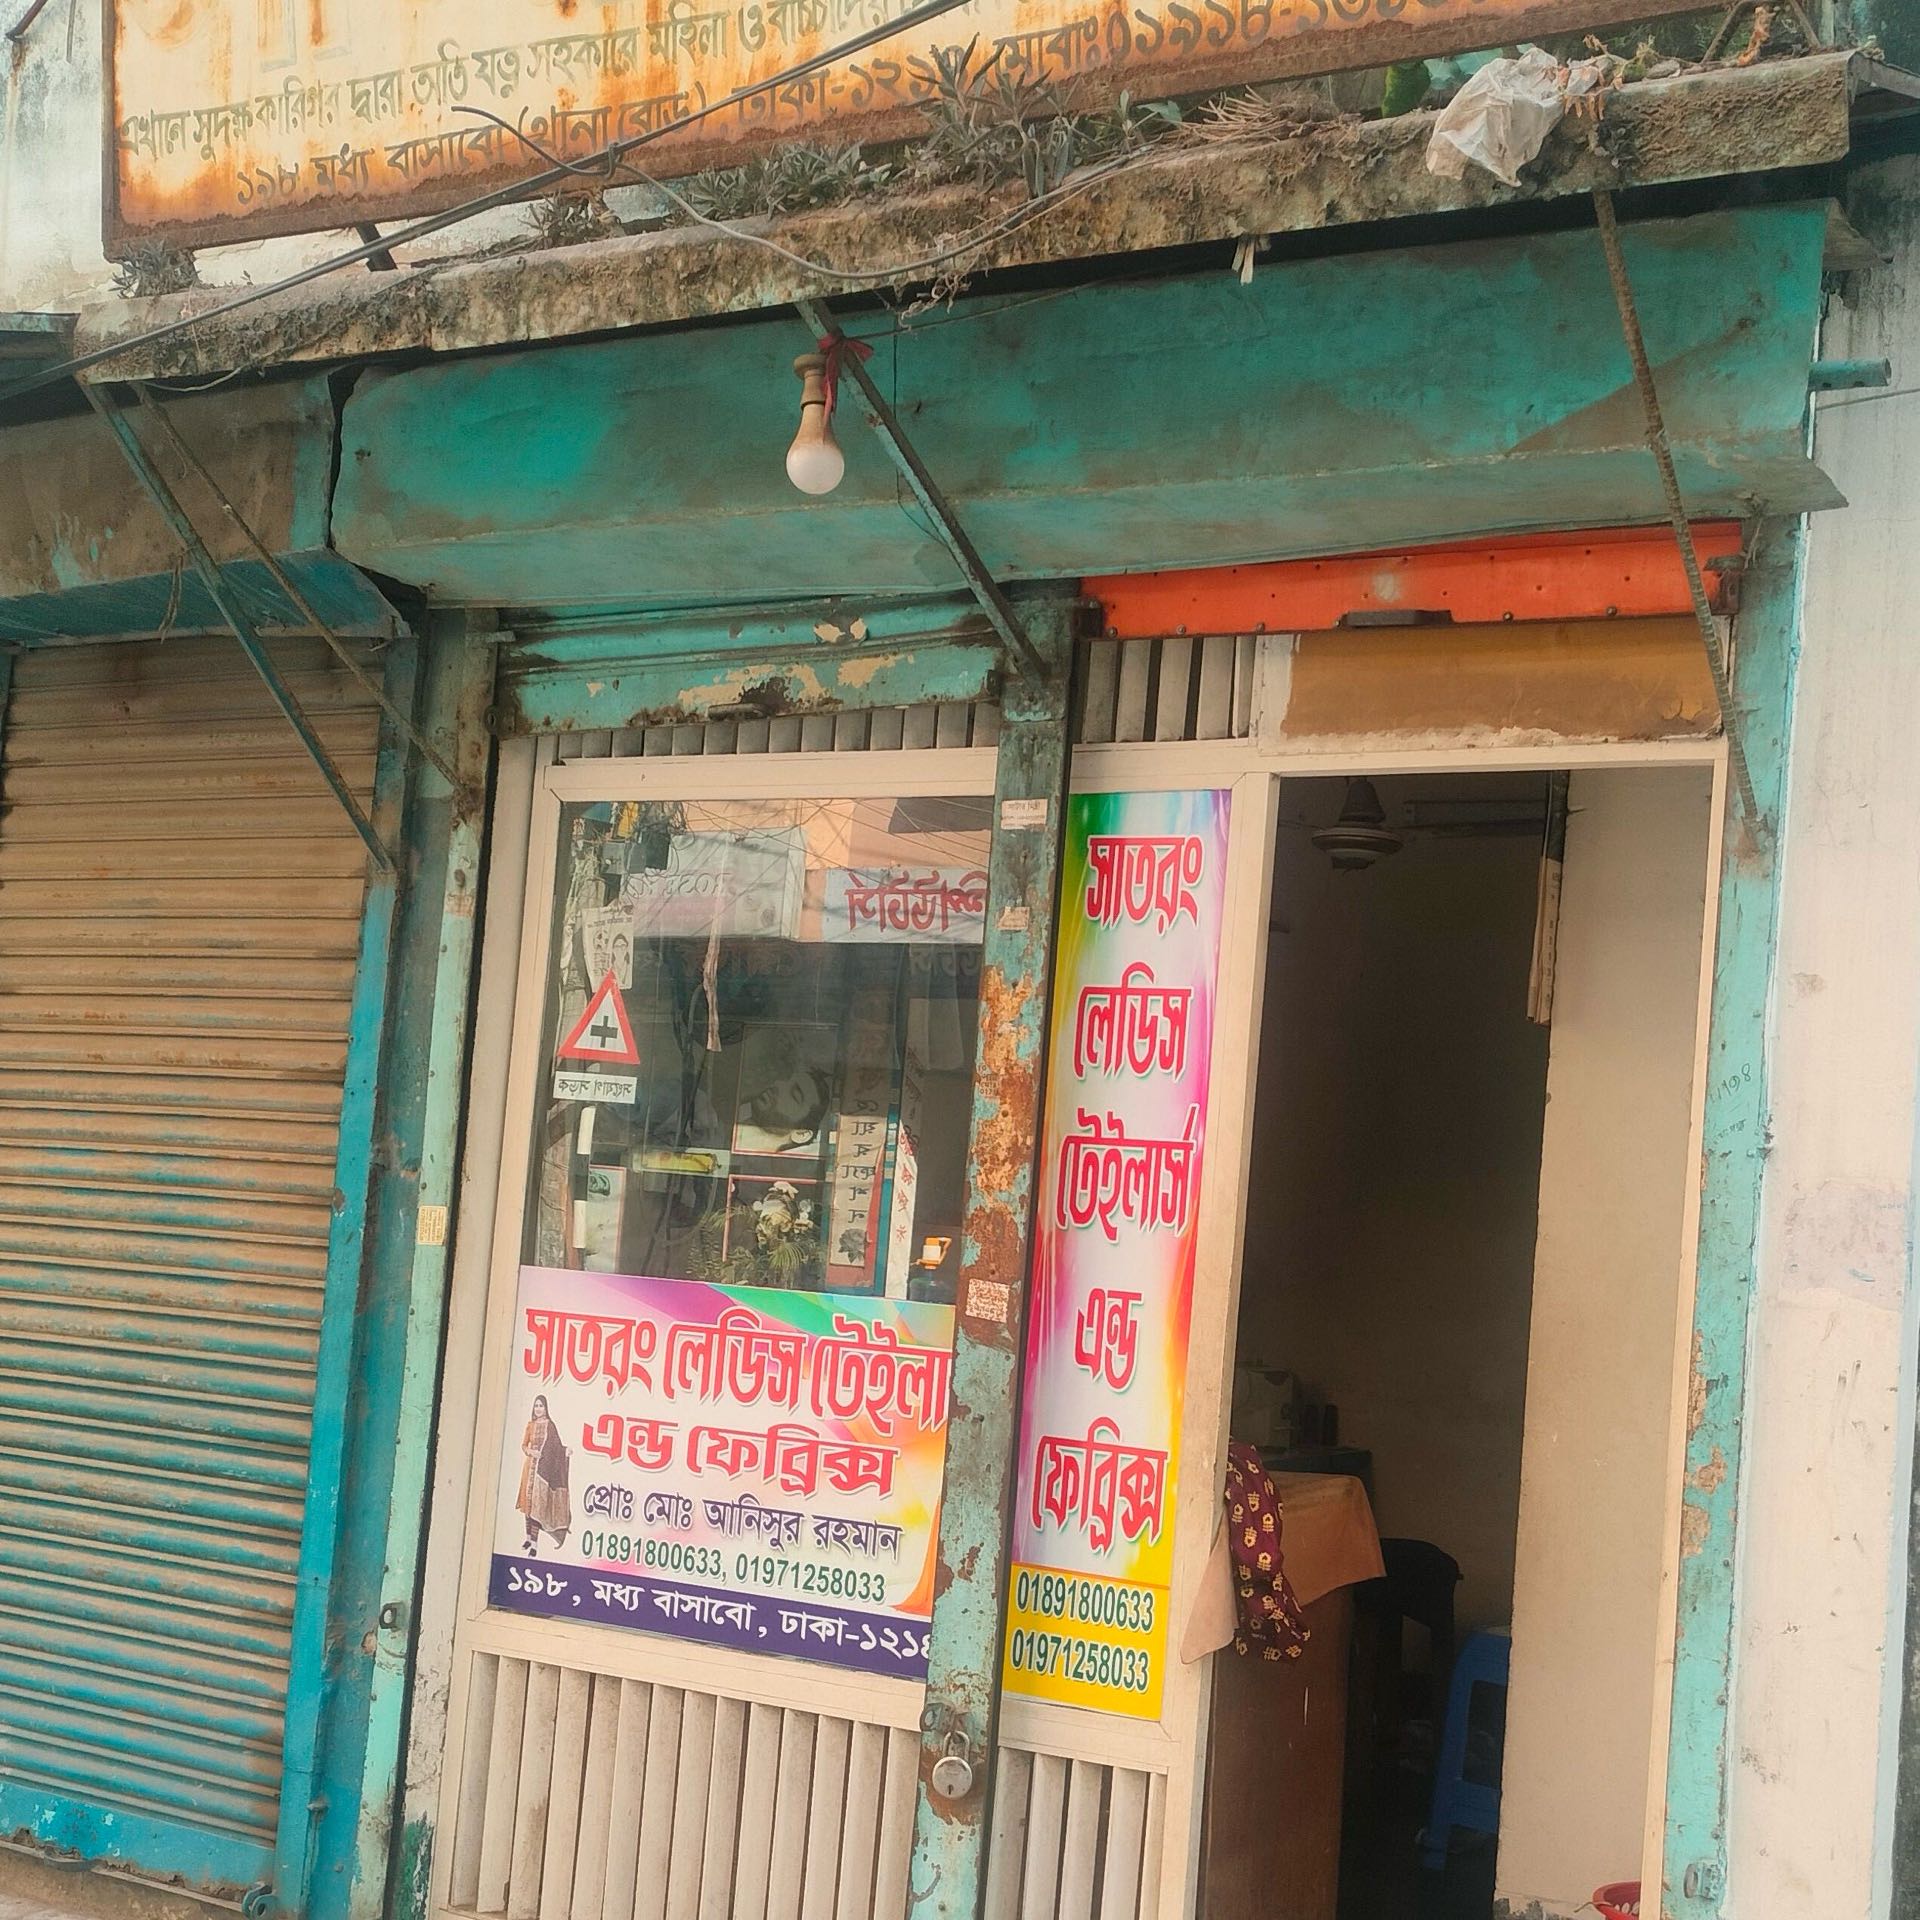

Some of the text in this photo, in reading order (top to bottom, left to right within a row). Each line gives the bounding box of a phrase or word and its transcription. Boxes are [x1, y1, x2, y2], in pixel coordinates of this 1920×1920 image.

[119, 108, 191, 161] এখানে
[191, 101, 253, 163] সুদক্ষ
[346, 69, 404, 123] দ্বারা
[409, 38, 469, 106] অতি
[526, 28, 641, 84] সহকারে
[646, 0, 732, 65] মহিলা
[737, 3, 767, 53] ও
[309, 143, 376, 198] মধ্য
[1087, 836, 1202, 934] সাতরং
[1074, 962, 1191, 1079] লেডিস
[1058, 1105, 1199, 1241] টেইলার্স
[524, 1308, 656, 1396] সাতরং
[663, 1308, 806, 1410] লেডিস
[1076, 1288, 1142, 1391] এন্ড
[582, 1413, 899, 1496] এন্ড ফেব্রিক্স
[1032, 1418, 1168, 1555] ফেব্রিক্স
[582, 1530, 885, 1601] 01891800633, 01971258033
[583, 1482, 903, 1559] প্রোঃ মোঃ আনিসুর রহমান
[591, 1578, 644, 1611] মধ্য
[1018, 1571, 1154, 1632] 01891800633
[1012, 1629, 1149, 1692] 01971258033
